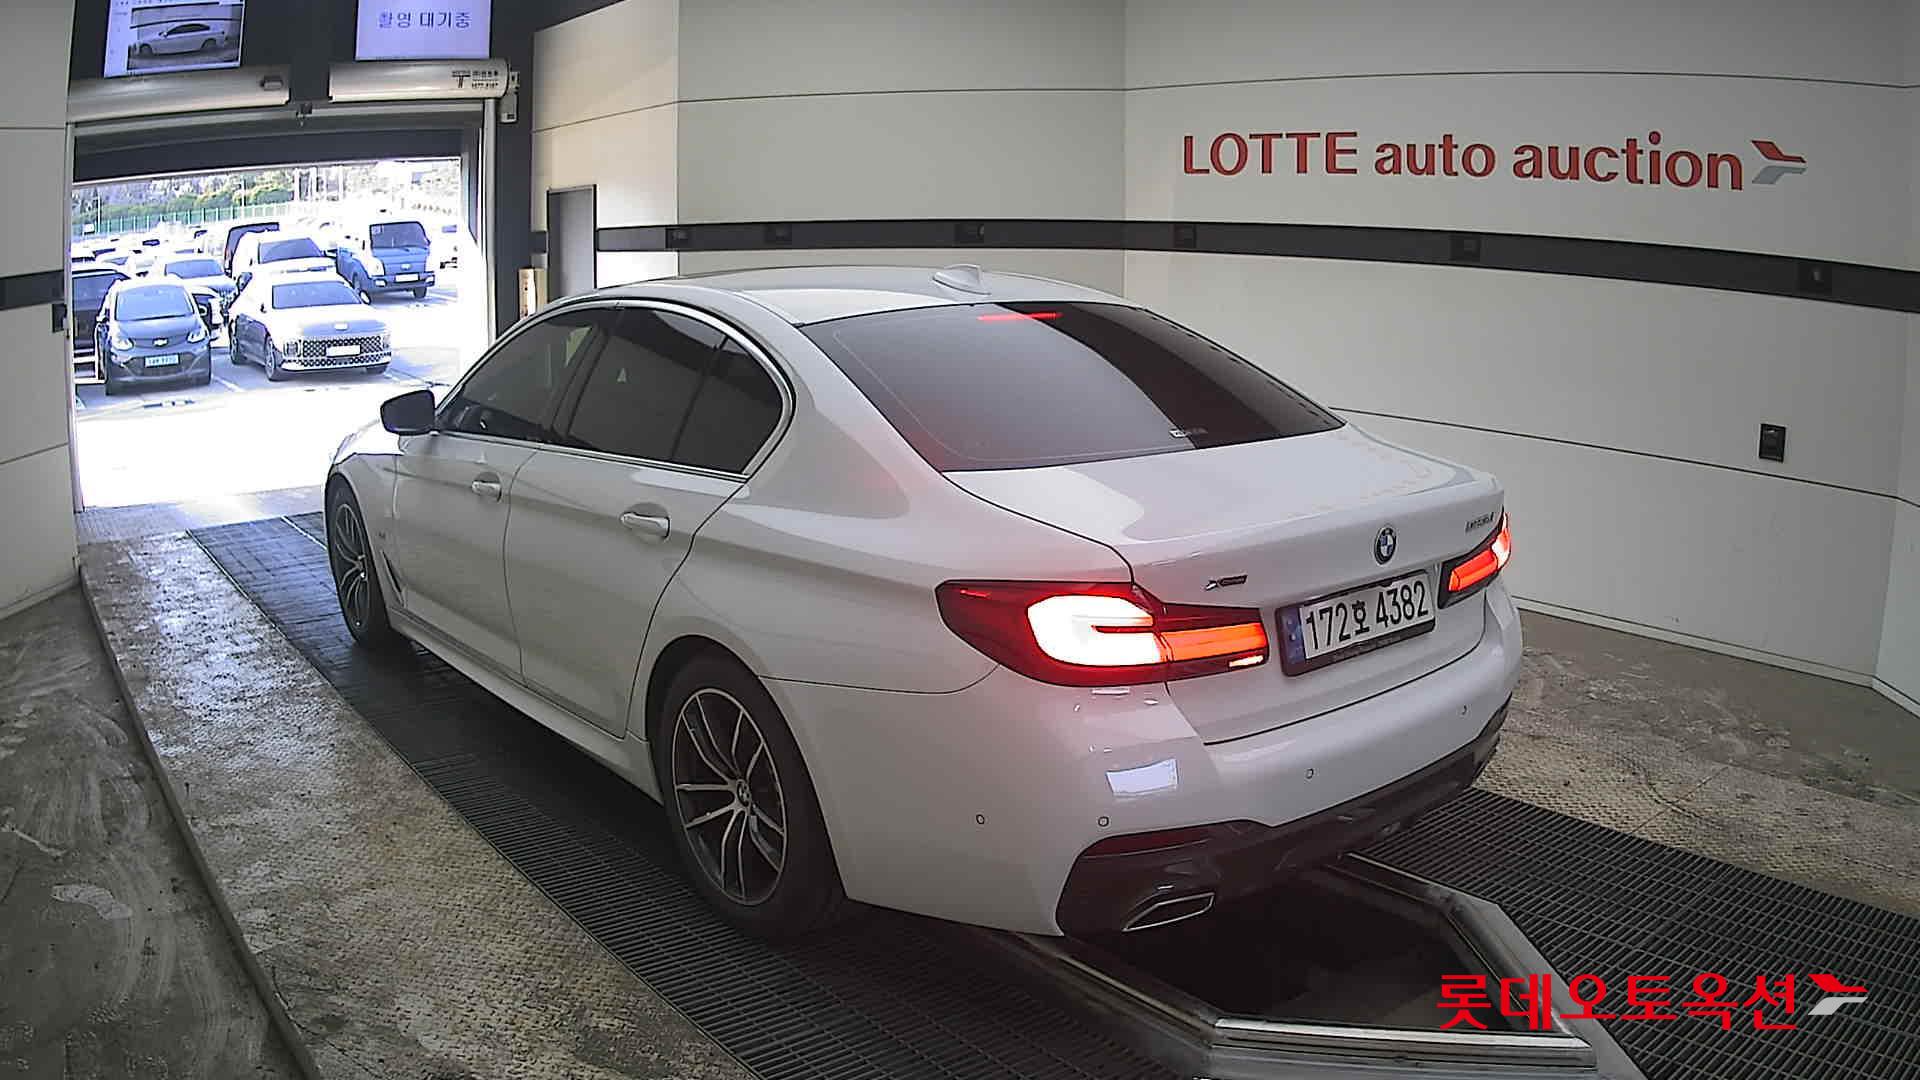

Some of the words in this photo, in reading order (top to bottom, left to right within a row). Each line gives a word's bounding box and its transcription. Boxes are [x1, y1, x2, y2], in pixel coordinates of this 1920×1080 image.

[419, 11, 471, 29] 대기중
[1183, 131, 1358, 175] LOTTE
[1374, 134, 1496, 177] auto
[1512, 131, 1744, 191] auction
[1305, 599, 1371, 650] 172호
[1375, 580, 1429, 628] 4382
